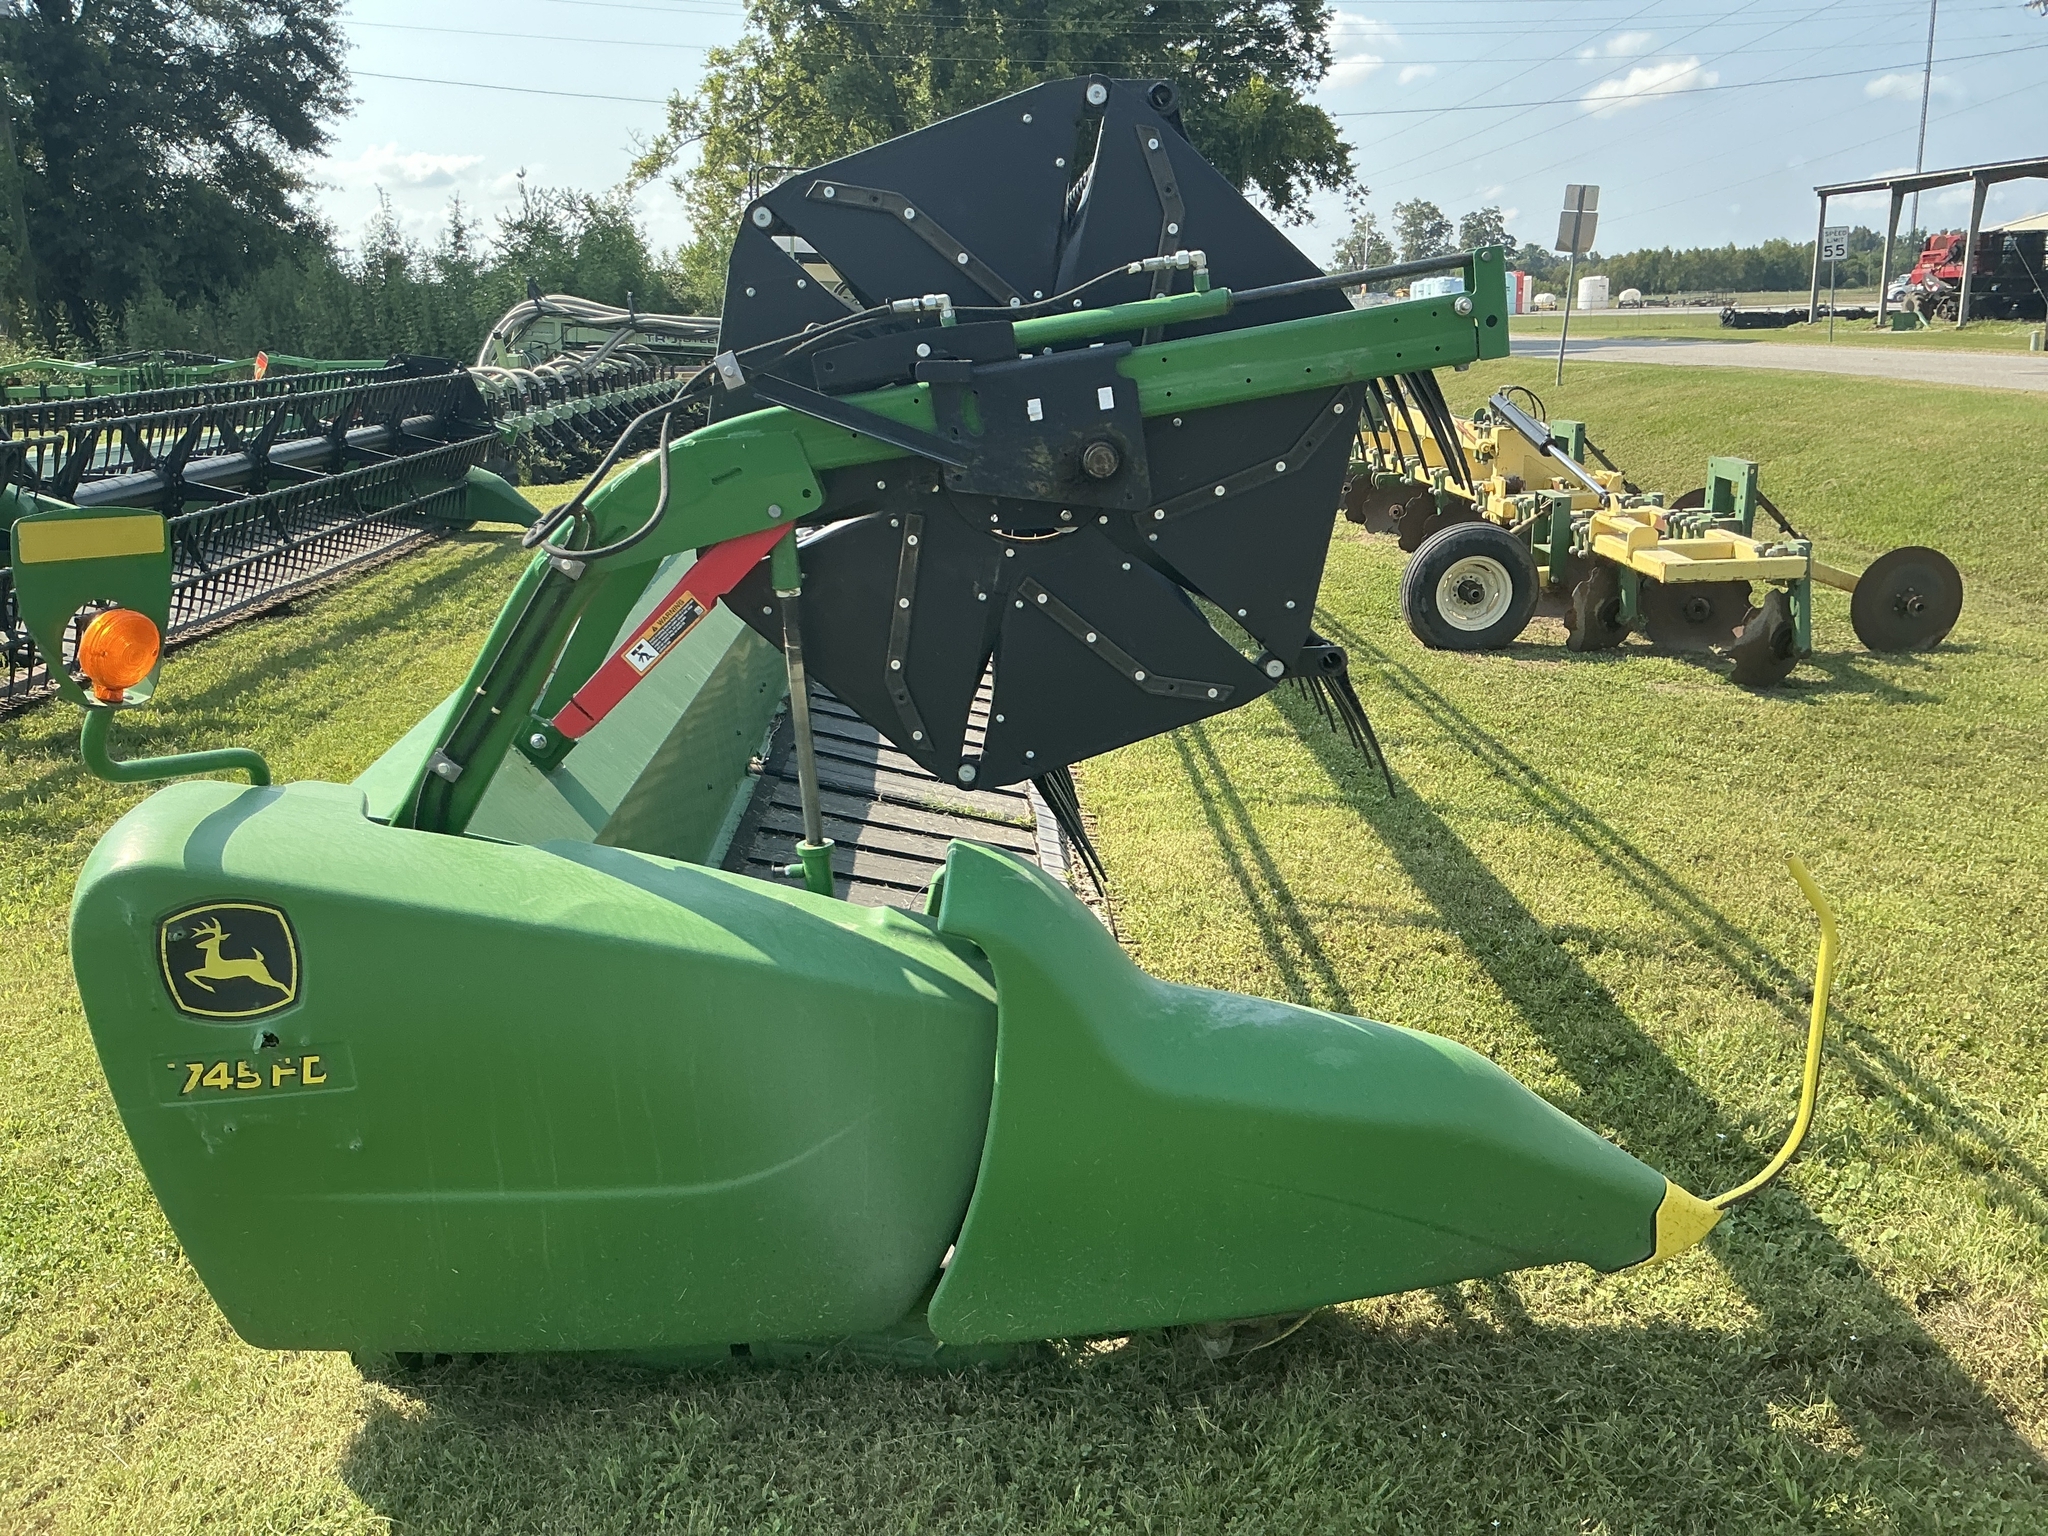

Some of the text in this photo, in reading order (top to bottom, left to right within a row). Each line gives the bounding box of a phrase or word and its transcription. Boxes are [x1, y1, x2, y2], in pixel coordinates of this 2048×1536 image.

[1824, 244, 1845, 258] 55
[657, 599, 685, 626] WARNING
[167, 1061, 262, 1094] 745
